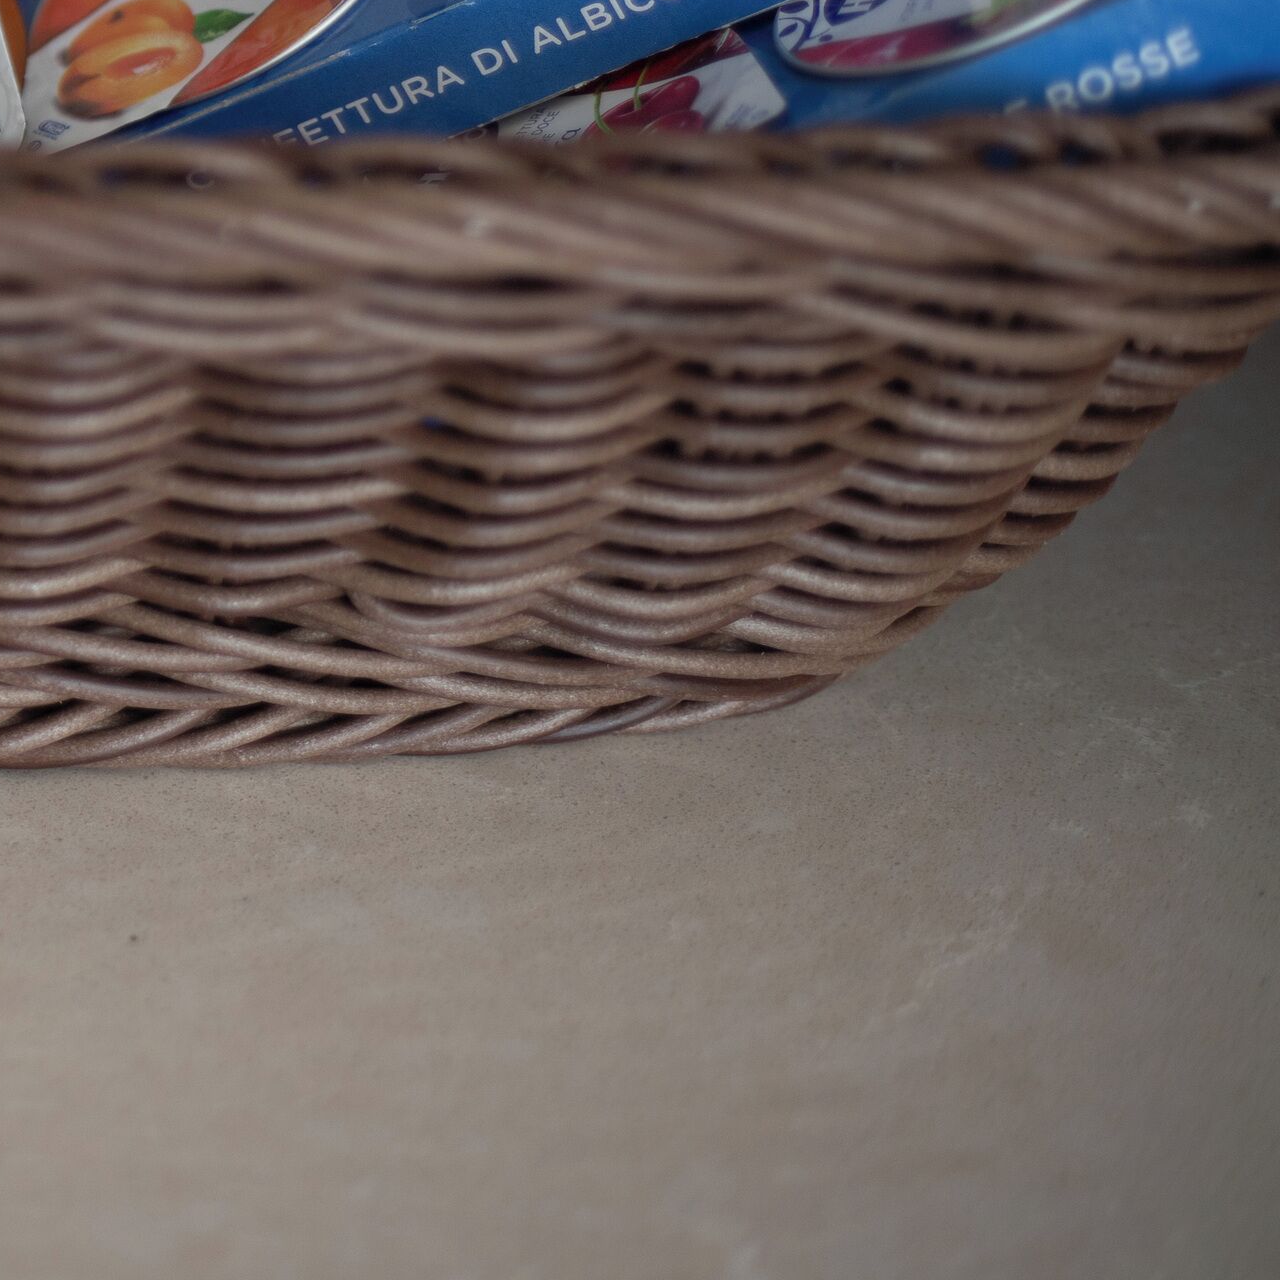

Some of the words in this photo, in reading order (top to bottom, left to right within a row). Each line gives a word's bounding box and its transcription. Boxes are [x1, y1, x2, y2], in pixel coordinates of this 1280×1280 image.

[276, 66, 464, 144] FETTURA
[471, 40, 518, 75] DI
[1049, 27, 1198, 98] ROSSE
